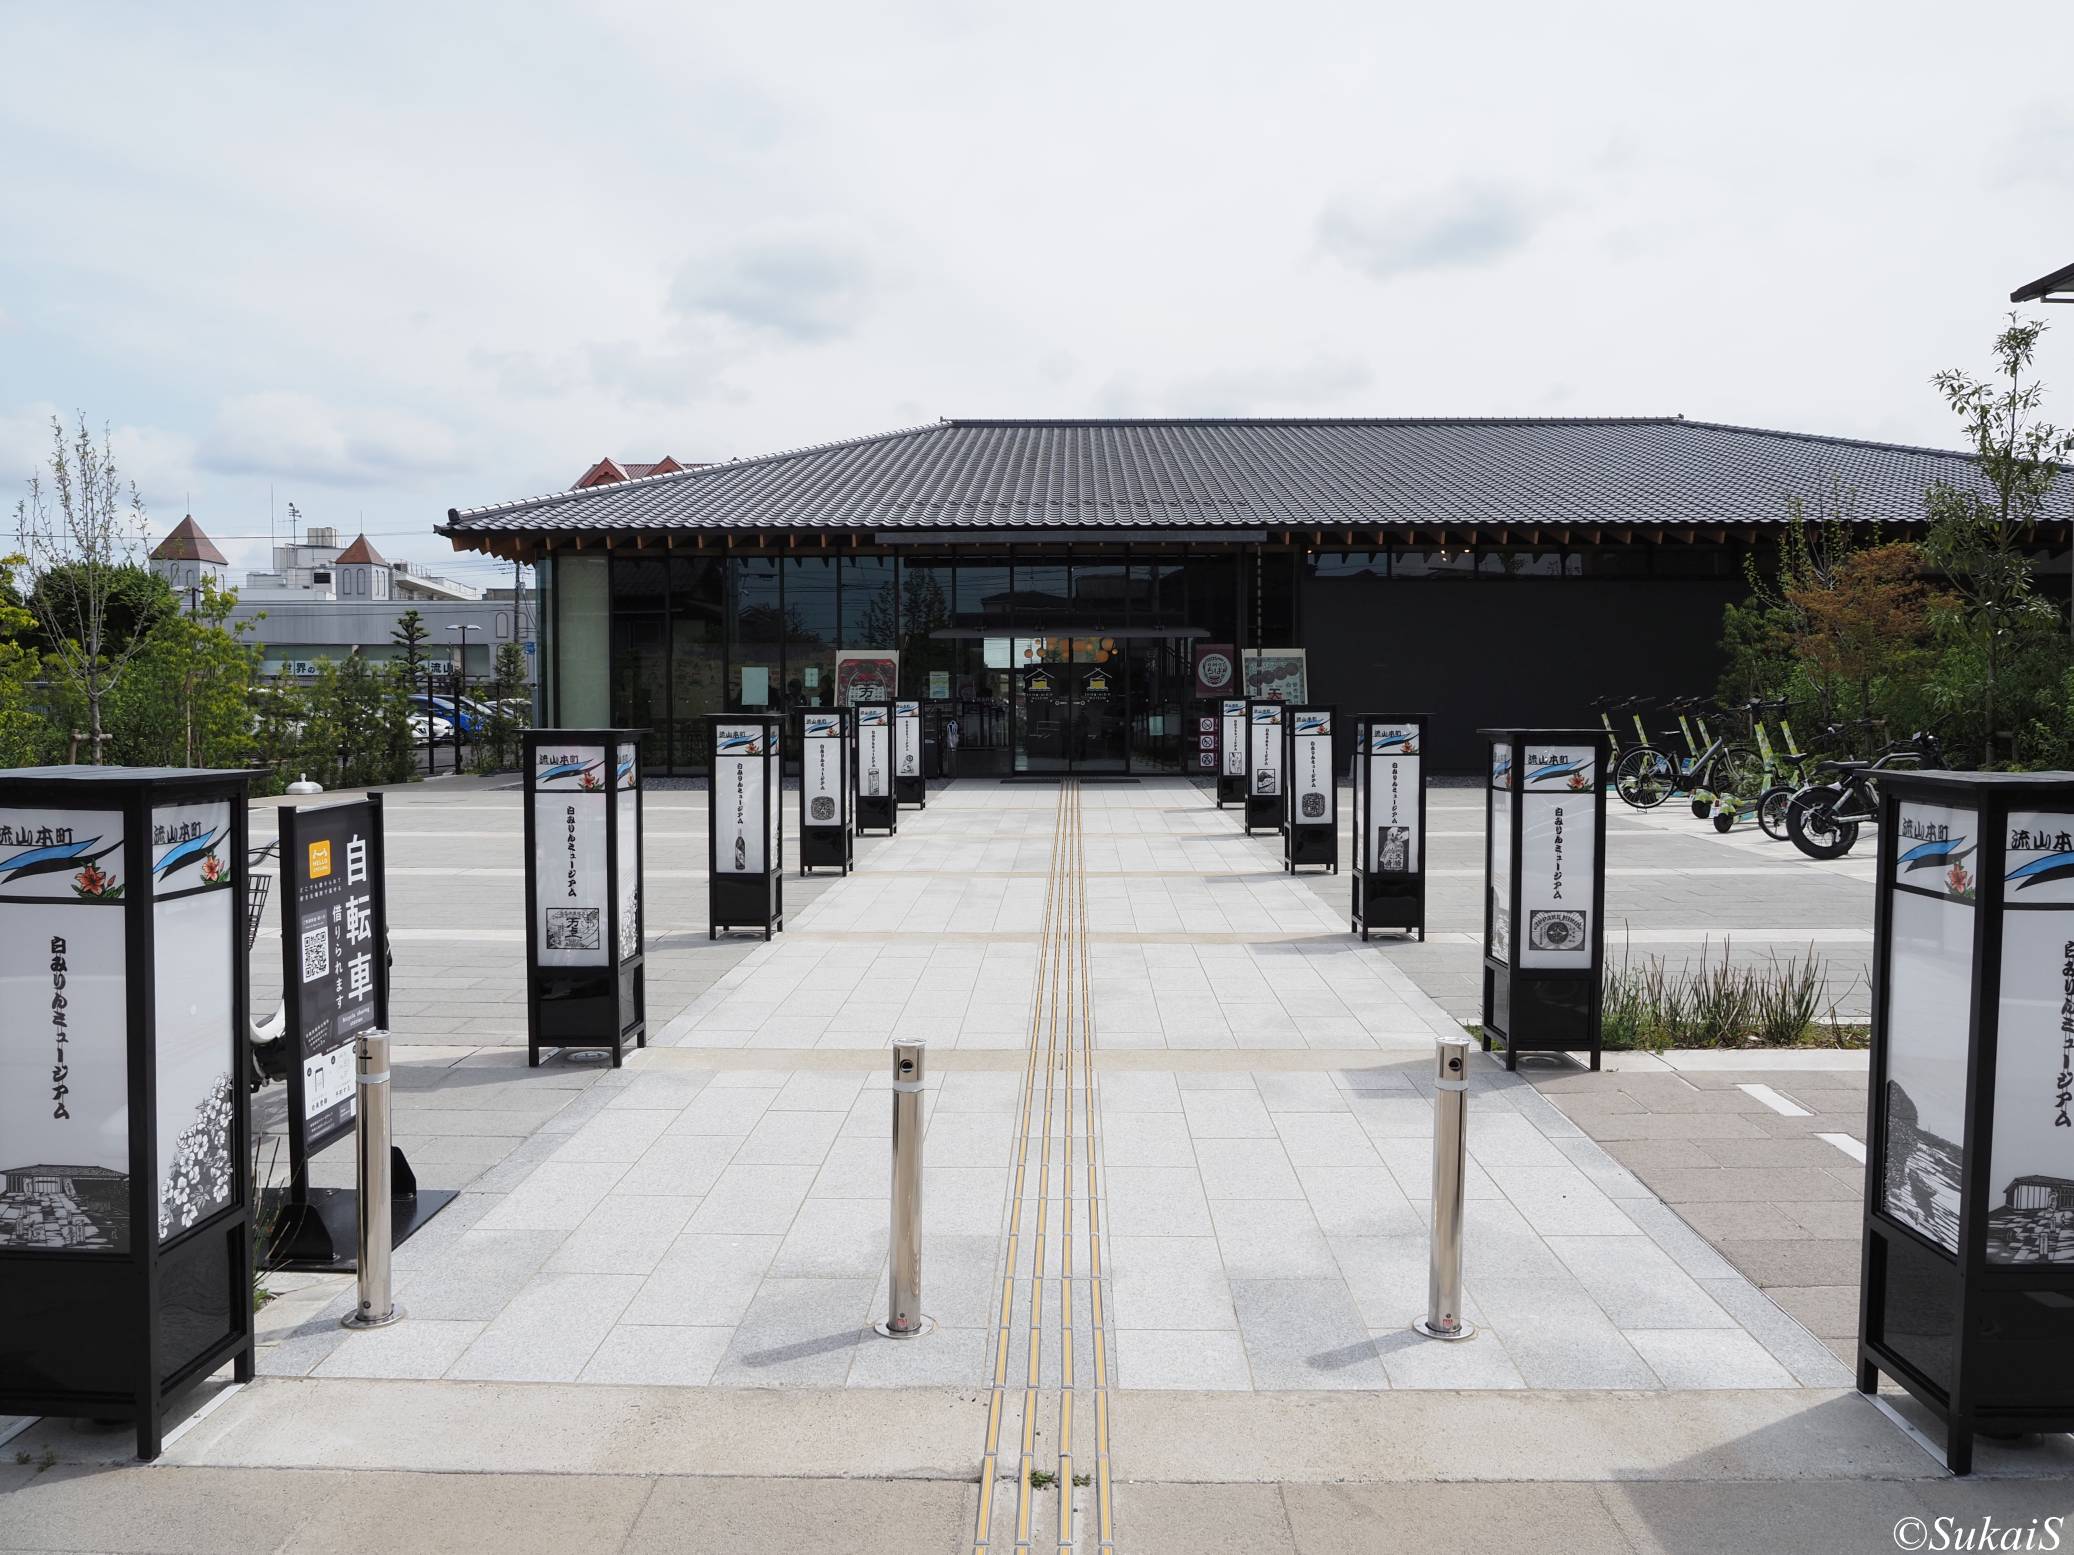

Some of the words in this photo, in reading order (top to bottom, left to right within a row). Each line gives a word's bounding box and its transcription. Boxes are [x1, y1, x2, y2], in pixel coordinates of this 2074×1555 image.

[539, 753, 579, 766] 流山本町
[1528, 755, 1569, 766] 流山本町
[0, 824, 73, 846] 流山本町
[154, 821, 202, 844] 流山本町
[567, 806, 577, 897] 白みりんミュージアム
[1554, 807, 1563, 899] 白みりんミュージアム
[1902, 818, 1950, 843] 流山本町
[345, 834, 373, 1002] 自転車
[332, 904, 344, 1009] 借りられます
[50, 935, 70, 1120] 白みりんミュージアム
